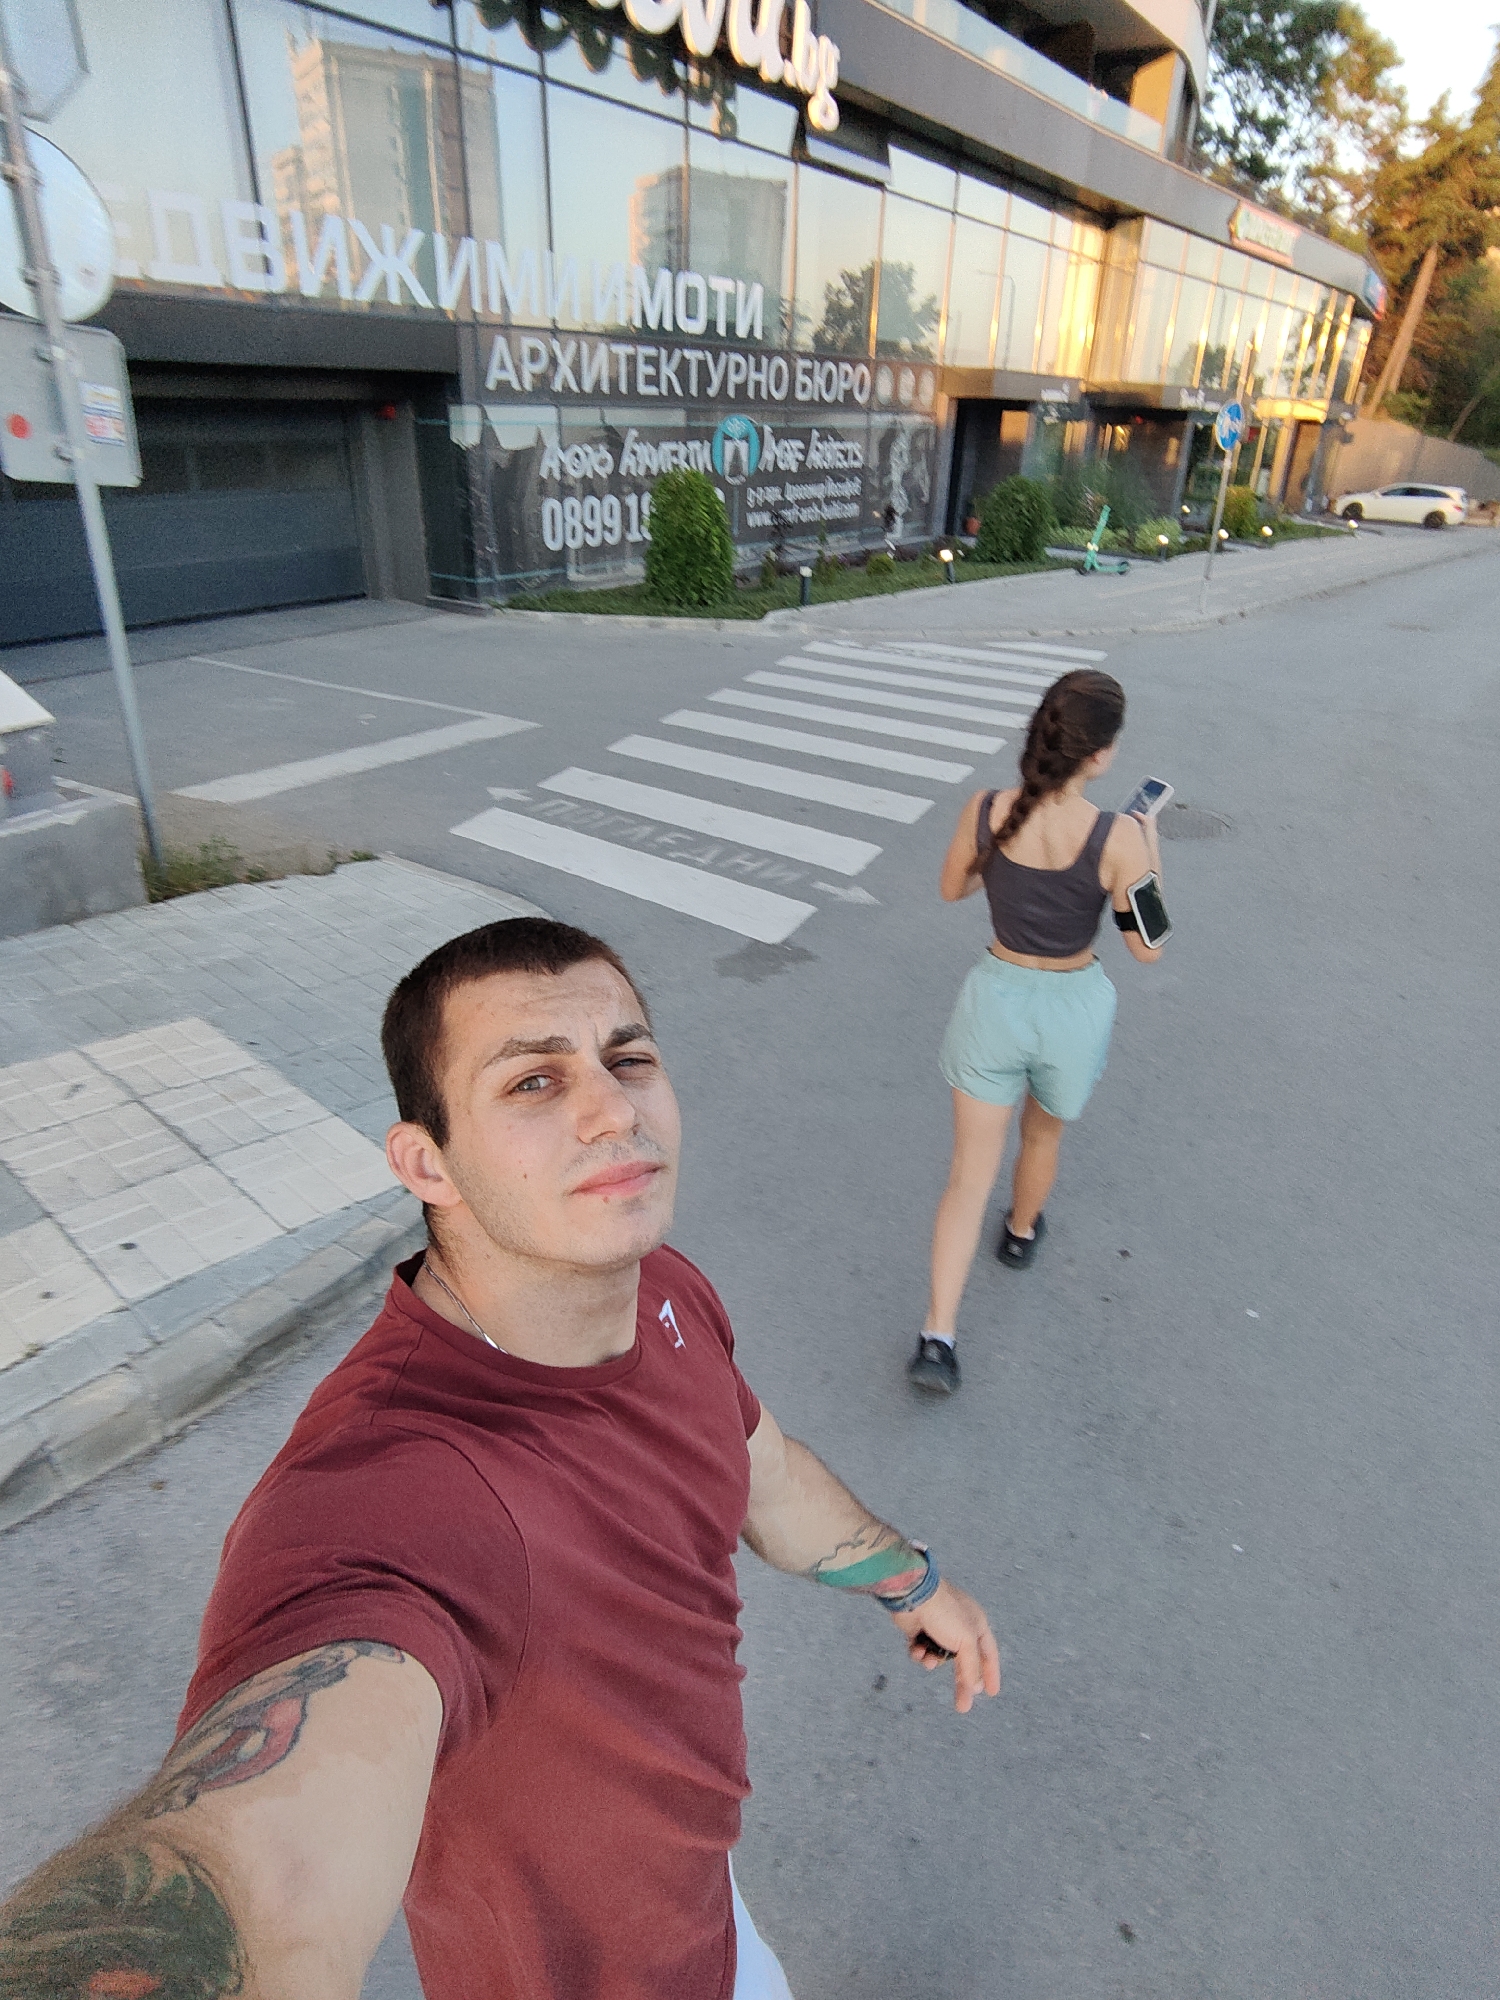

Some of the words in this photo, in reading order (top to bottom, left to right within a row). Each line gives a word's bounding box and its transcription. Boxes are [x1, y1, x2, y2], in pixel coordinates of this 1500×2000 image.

[590, 258, 765, 341] ИМОТИ
[485, 333, 790, 401] АРХИТЕКТУРНО
[795, 357, 872, 405] БЮРО
[541, 493, 623, 551] 0899
[528, 799, 810, 885] ПОГЛЕДНИ
